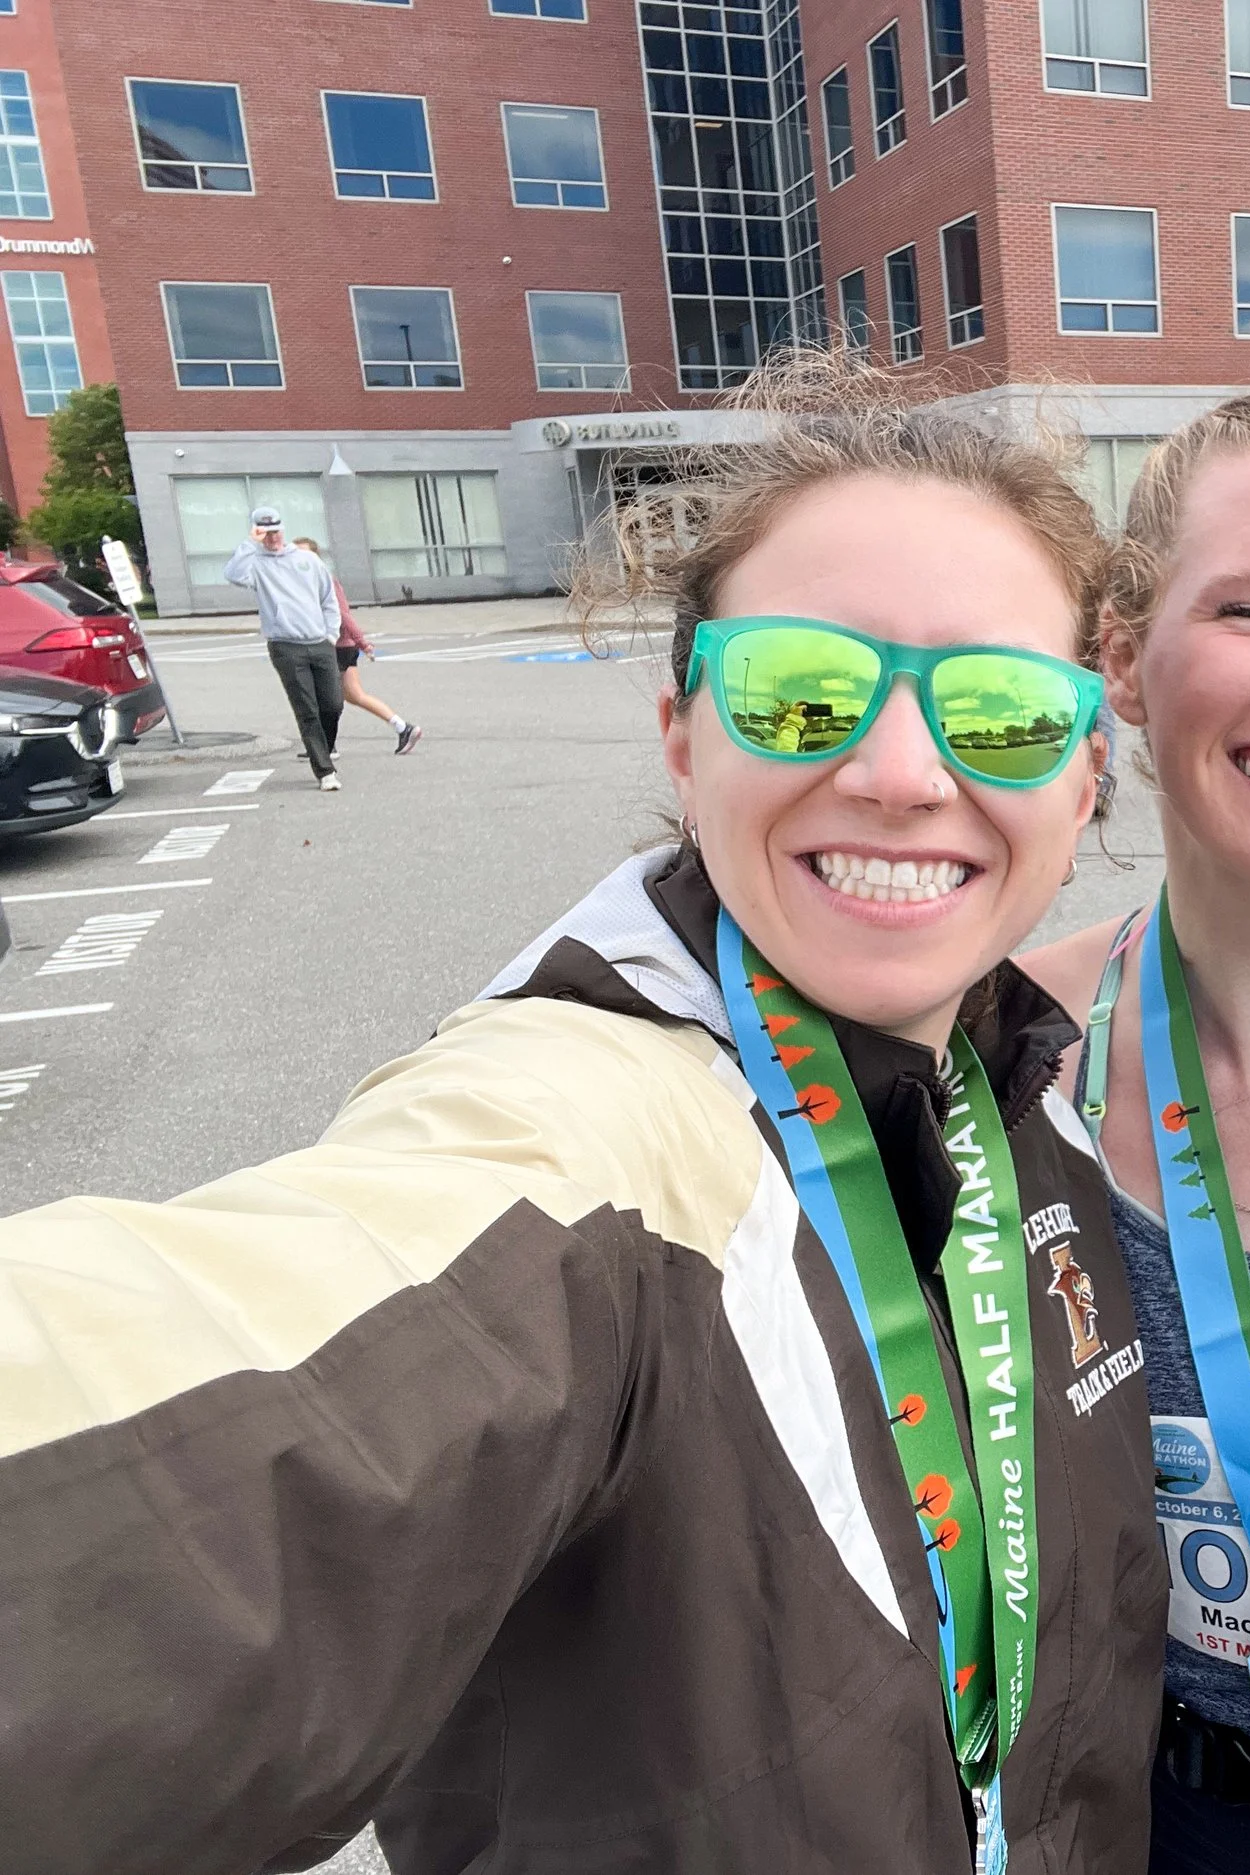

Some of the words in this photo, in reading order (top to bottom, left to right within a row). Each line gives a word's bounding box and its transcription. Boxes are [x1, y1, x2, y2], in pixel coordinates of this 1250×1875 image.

[972, 1293, 1018, 1442] HALF
[1154, 1453, 1207, 1467] RATHON
[1155, 1501, 1209, 1516] ctober
[1213, 1506, 1228, 1521] 6,
[998, 1458, 1029, 1623] Maine
[1196, 1632, 1230, 1653] 1ST
